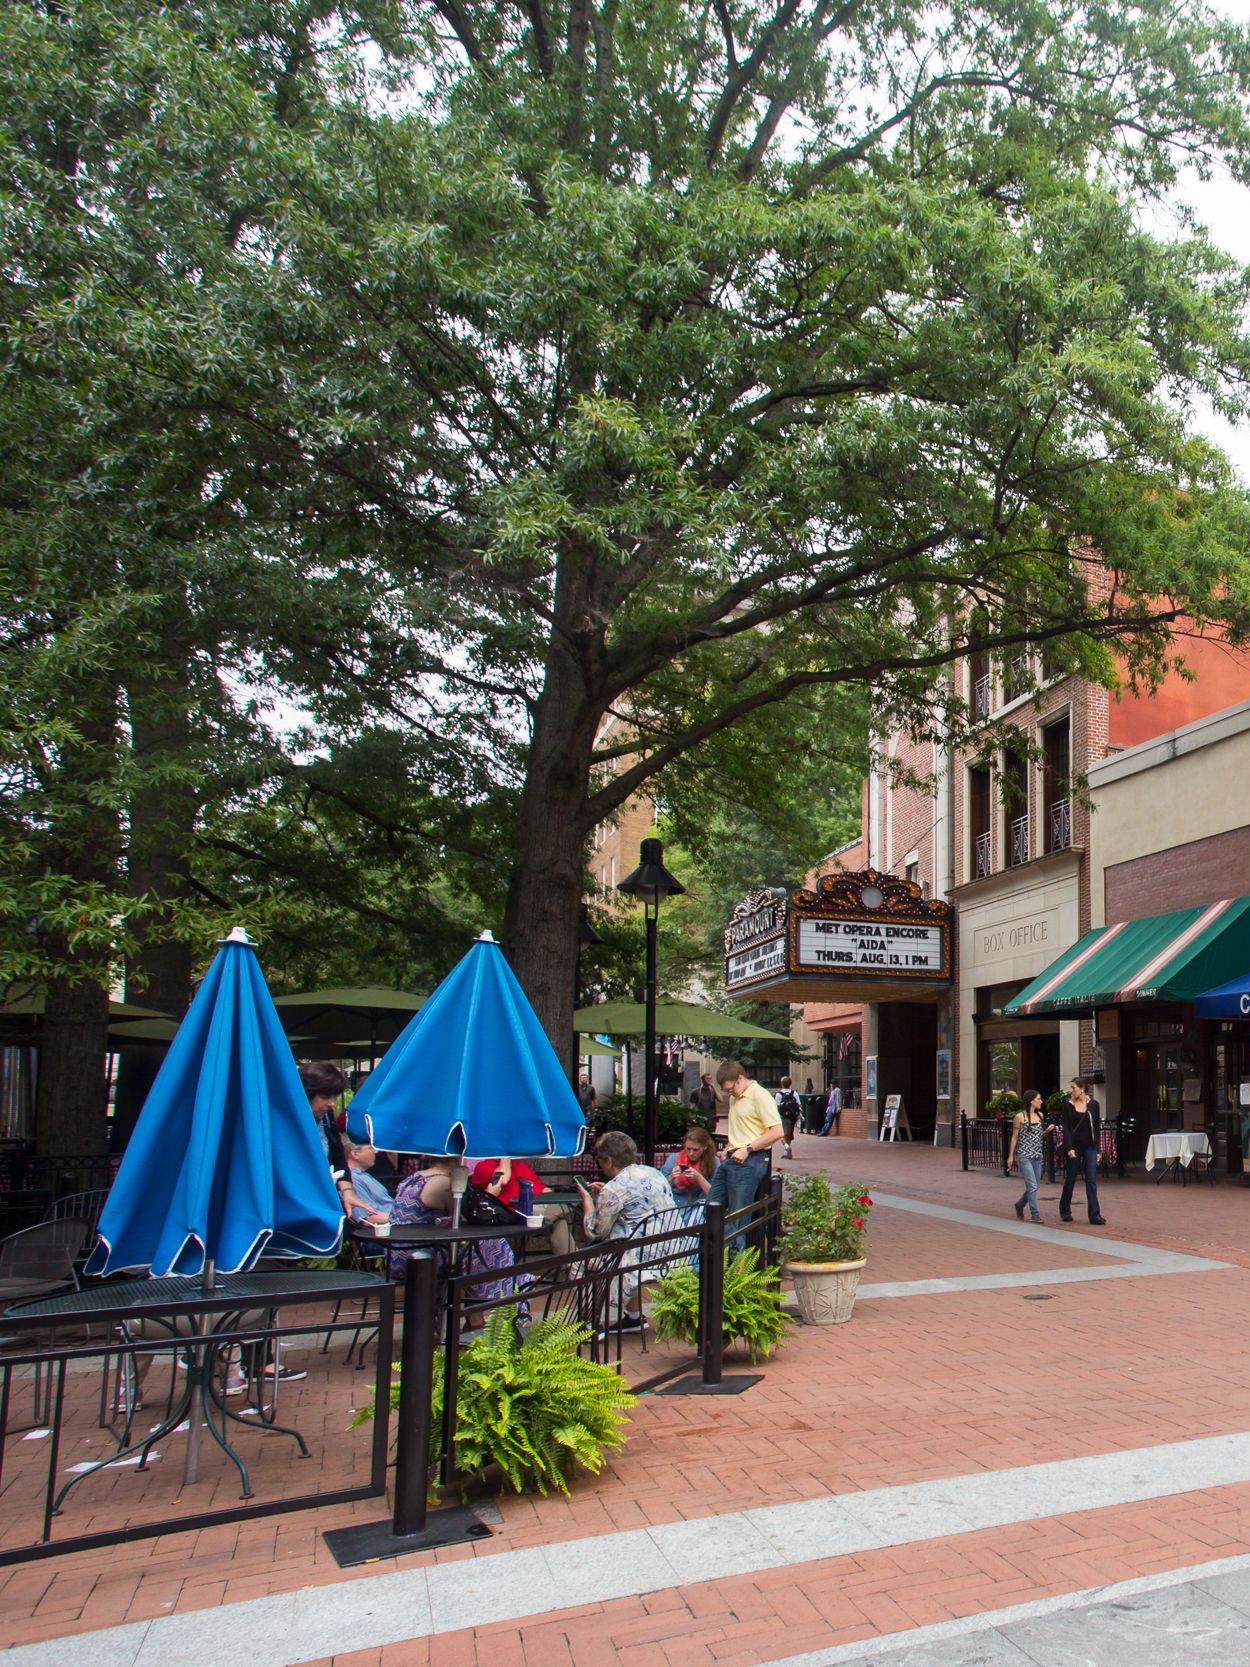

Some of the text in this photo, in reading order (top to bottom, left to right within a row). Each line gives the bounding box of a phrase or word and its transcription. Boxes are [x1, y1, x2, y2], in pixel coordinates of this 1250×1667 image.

[731, 907, 774, 945] PARAMOUNT
[815, 922, 930, 940] MET OPERA ENCORE
[983, 920, 1048, 954] BOX OFFICE
[911, 955, 929, 966] PM
